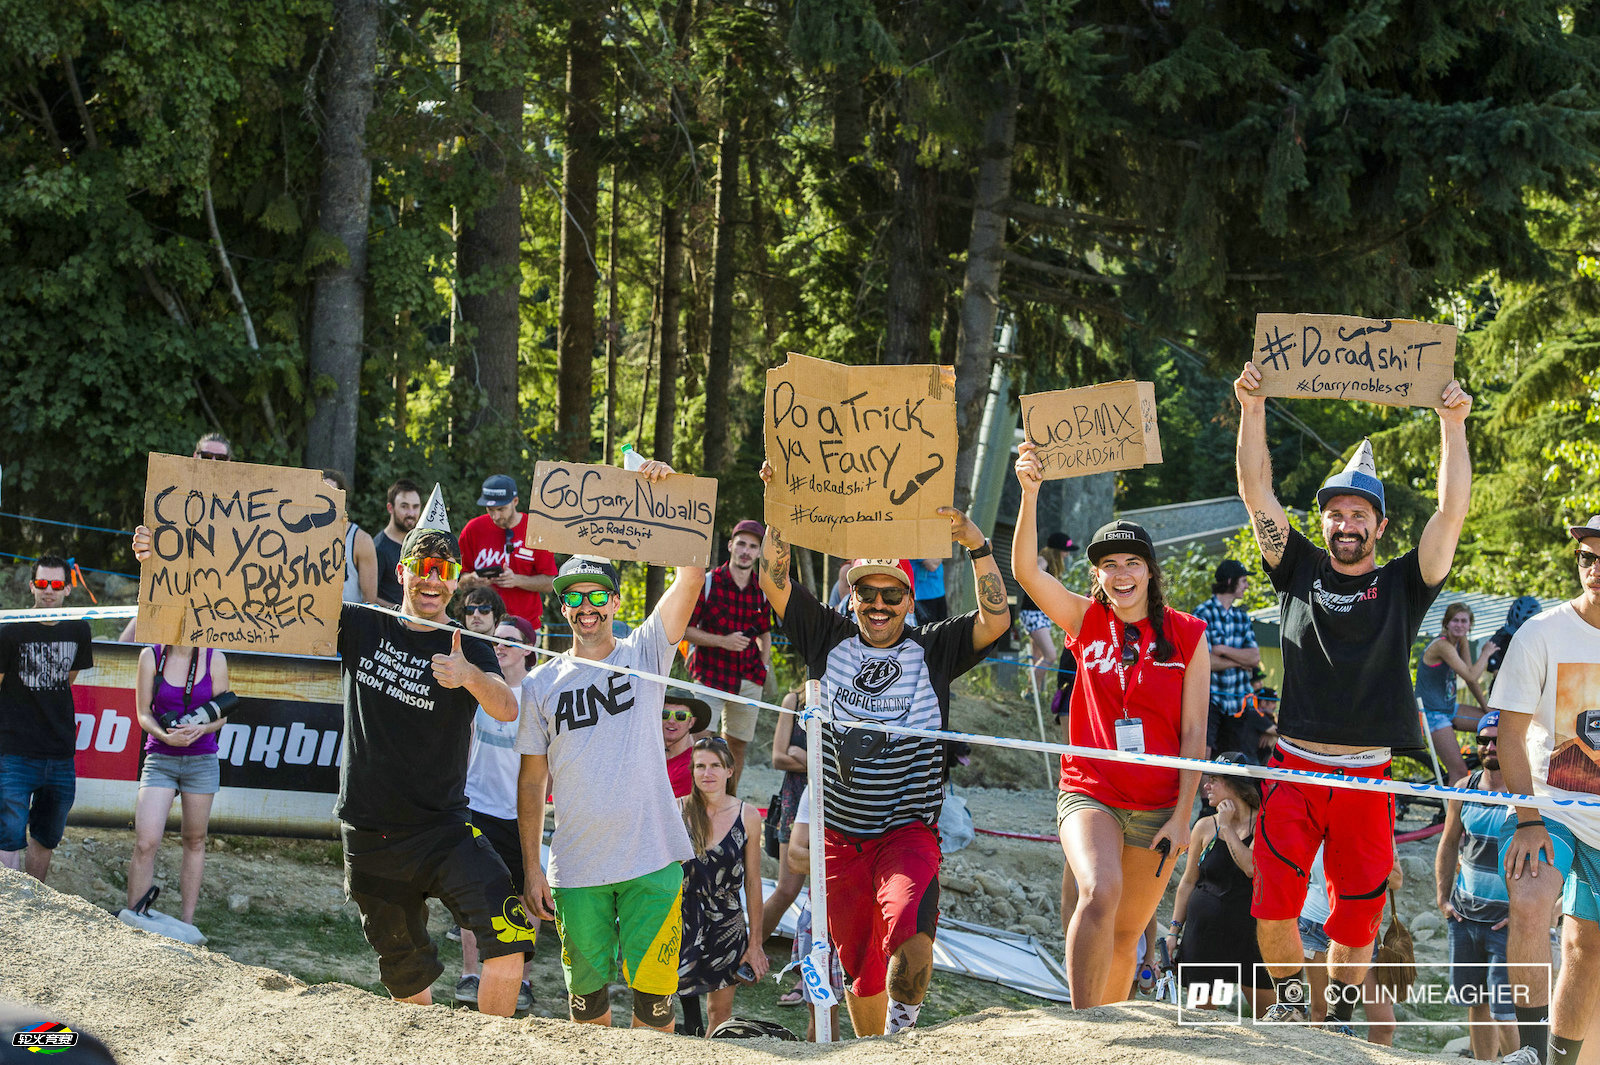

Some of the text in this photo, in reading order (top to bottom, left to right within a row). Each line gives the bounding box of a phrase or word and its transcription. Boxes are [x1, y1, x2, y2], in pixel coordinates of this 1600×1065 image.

[154, 486, 278, 526] COME
[154, 523, 216, 562] ON
[1107, 532, 1131, 540] SMITH
[359, 656, 431, 697] TO THE CHICK
[373, 649, 425, 681] VIRGINITY
[410, 655, 431, 669] MY
[355, 669, 435, 712] FROM HANSON
